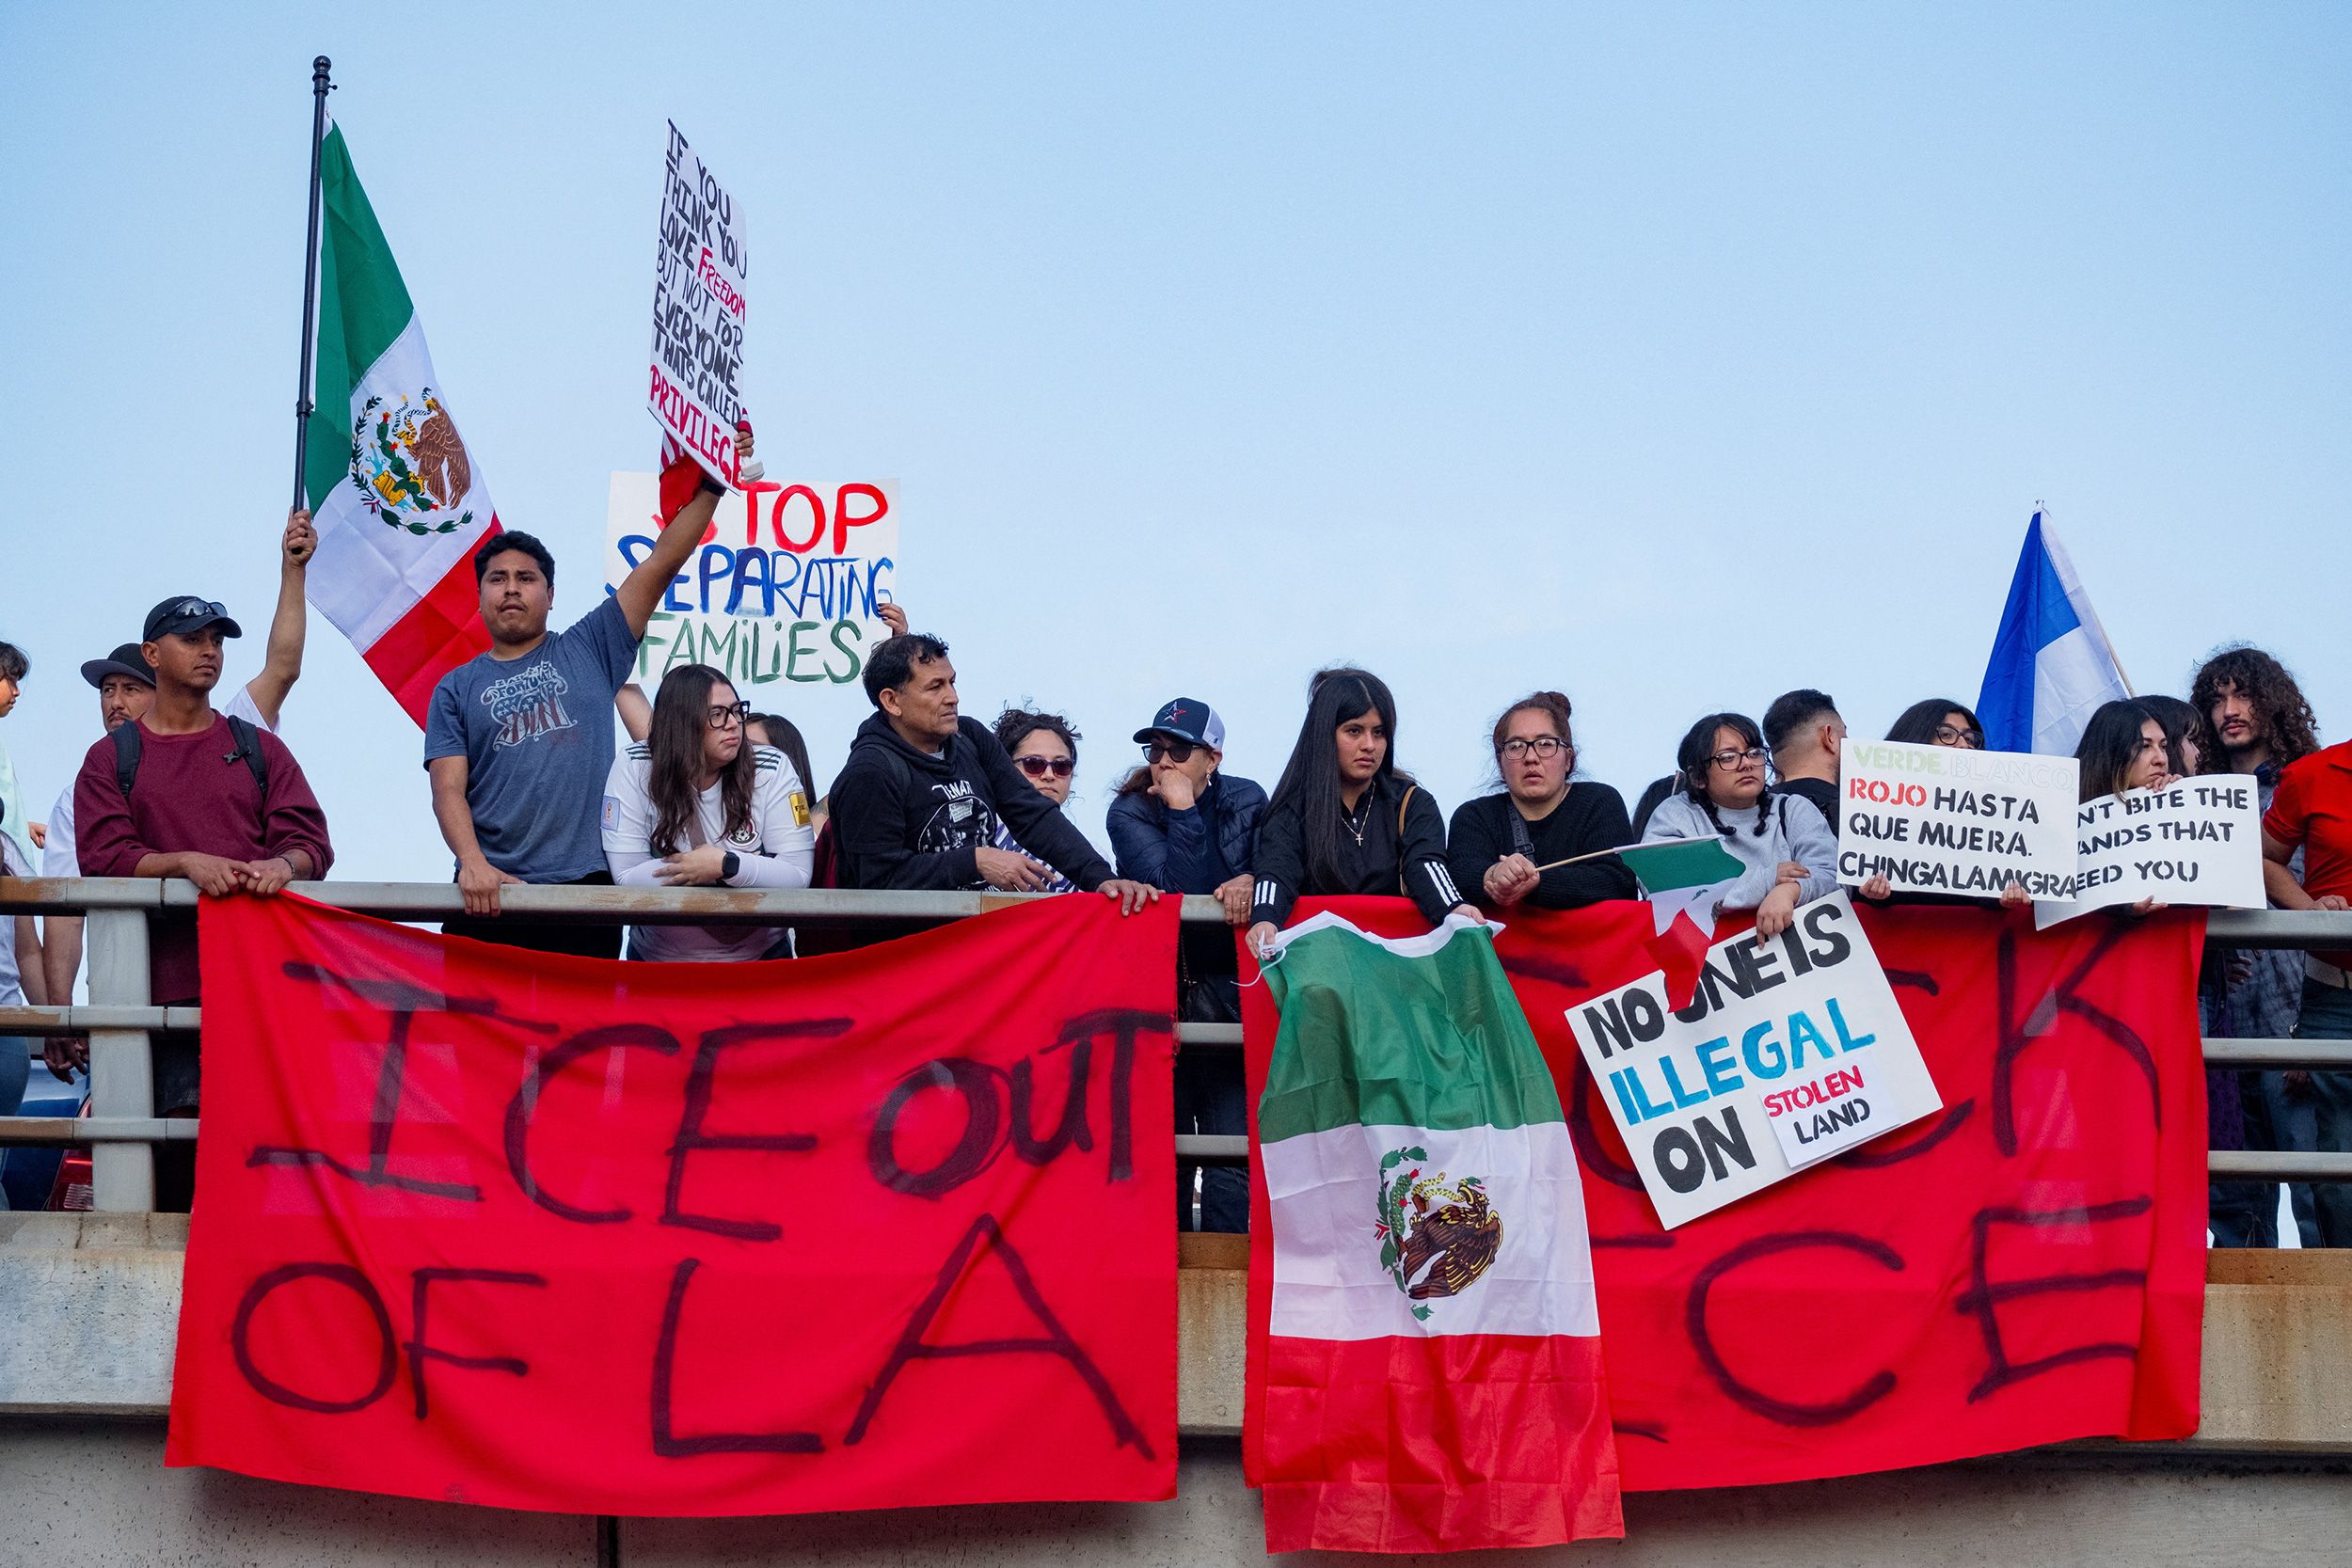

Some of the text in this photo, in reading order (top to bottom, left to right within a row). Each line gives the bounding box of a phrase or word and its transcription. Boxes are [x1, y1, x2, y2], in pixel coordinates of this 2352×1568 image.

[665, 158, 747, 279] THINK YOU
[667, 118, 731, 226] IF YOU
[656, 239, 743, 365] BUT NOT FOR
[660, 197, 746, 325] LOVE FREEDOM
[653, 280, 739, 397] EVERYONE
[654, 318, 743, 433] THATS CALLED
[1849, 777, 2040, 824] ROJO HASTA
[1852, 744, 1947, 776] VERDE,
[2125, 789, 2185, 816] BITE
[2194, 787, 2249, 810] THE
[1849, 812, 2033, 857] QUE MUERA.
[2076, 860, 2199, 892] EED YOU
[2077, 820, 2234, 855] ANDS THAT
[1582, 987, 1665, 1059] NO
[1779, 903, 1851, 977] IS
[245, 959, 856, 1242] ICE
[1608, 997, 1877, 1127] ILLEGAL
[1763, 1064, 1865, 1117] STOLEN
[1652, 1105, 1757, 1194] ON
[1792, 1098, 1871, 1145] LAND
[230, 1212, 1156, 1461] OF LA
